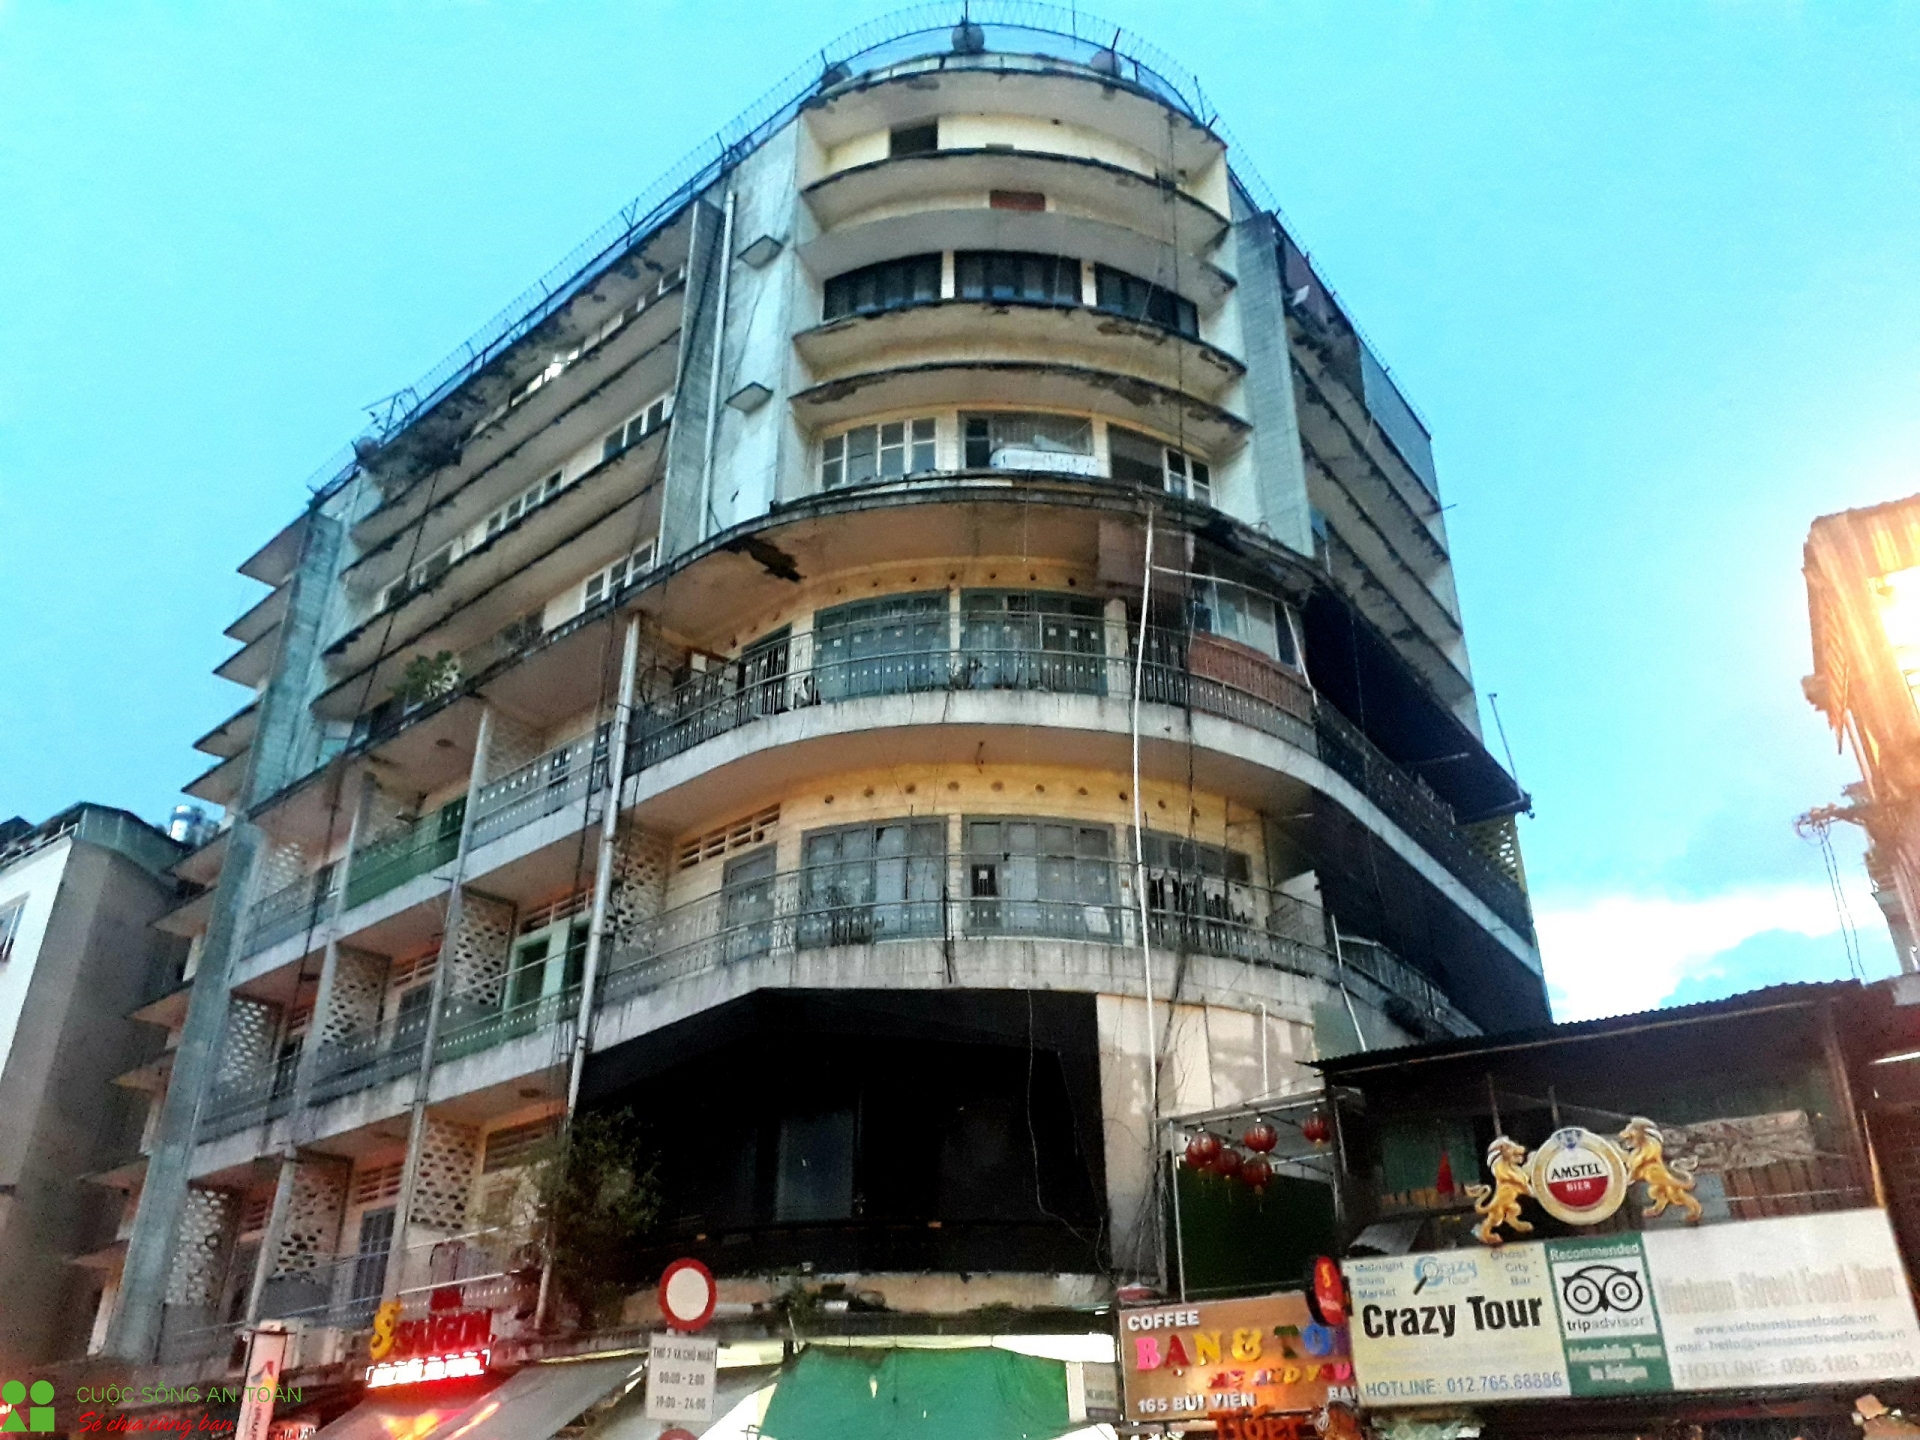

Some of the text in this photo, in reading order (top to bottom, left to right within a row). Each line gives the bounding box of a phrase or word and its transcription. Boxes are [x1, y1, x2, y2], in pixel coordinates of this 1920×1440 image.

[1551, 1163, 1602, 1180] AMSTEL
[1566, 1181, 1591, 1191] BIER
[1550, 1244, 1639, 1260] Recommended
[1505, 1263, 1529, 1273] City
[1127, 1311, 1200, 1331] COFFEE
[1362, 1295, 1543, 1340] Crazy Tour
[1566, 1315, 1644, 1334] tripadvisor
[1365, 1378, 1442, 1397] HOTLINE:
[1138, 1397, 1169, 1413] 165
